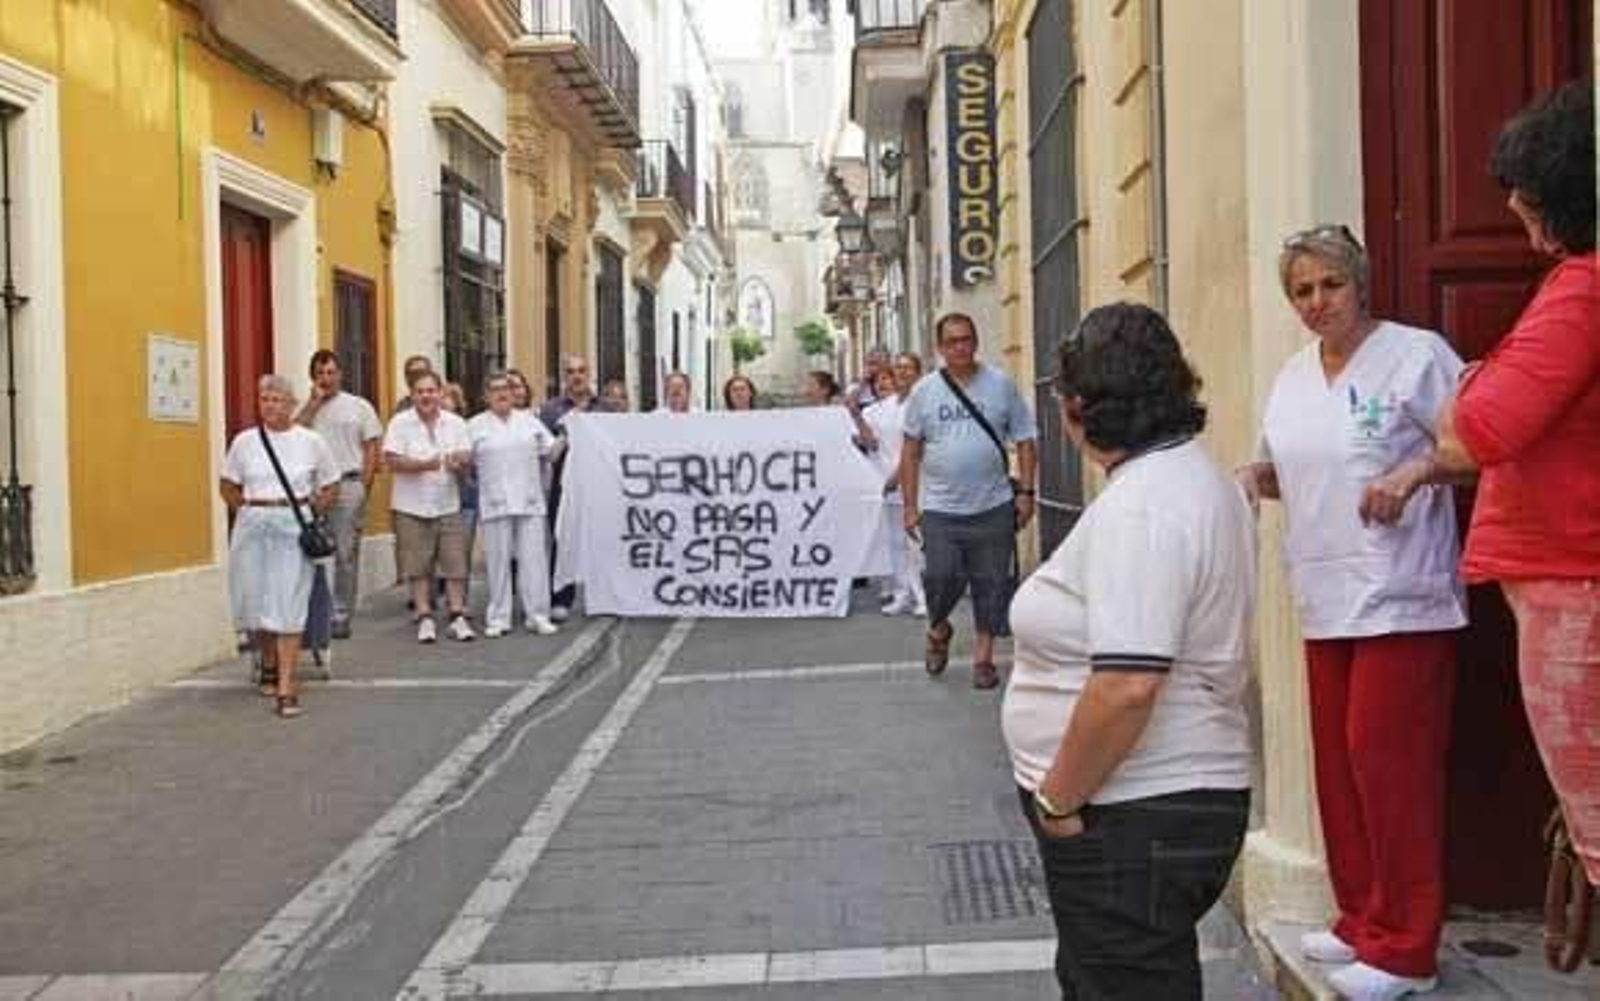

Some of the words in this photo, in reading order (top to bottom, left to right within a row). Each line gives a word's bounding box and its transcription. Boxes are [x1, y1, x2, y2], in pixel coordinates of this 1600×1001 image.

[621, 506, 677, 541] NO
[693, 501, 777, 534] PAGA
[799, 496, 826, 532] Y
[629, 542, 675, 569] EL
[683, 535, 772, 574] SAS
[792, 544, 832, 568] LO
